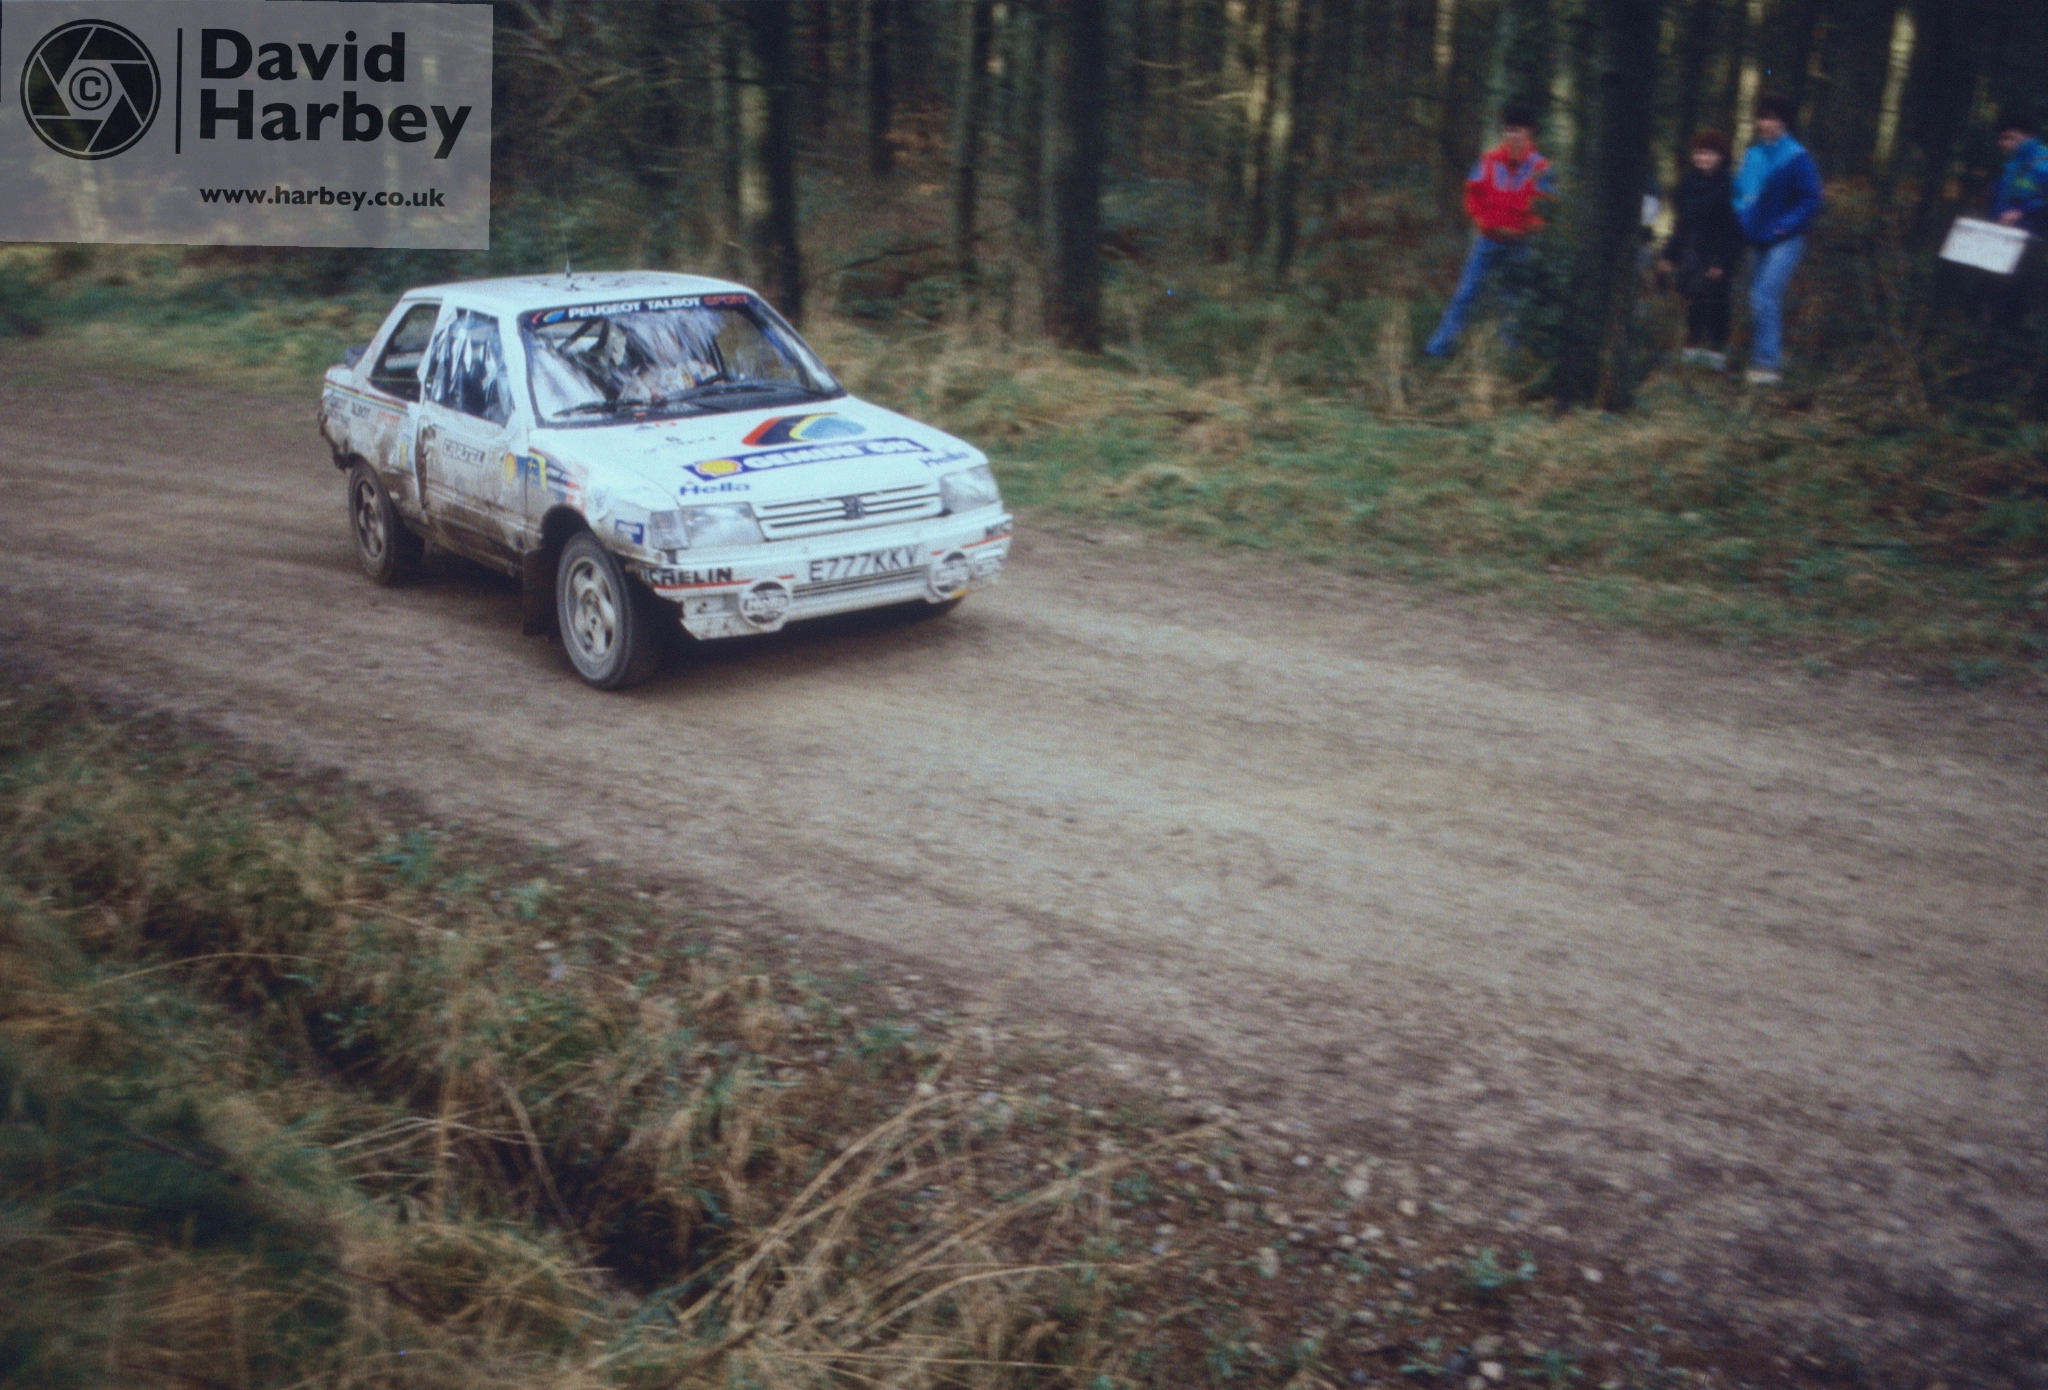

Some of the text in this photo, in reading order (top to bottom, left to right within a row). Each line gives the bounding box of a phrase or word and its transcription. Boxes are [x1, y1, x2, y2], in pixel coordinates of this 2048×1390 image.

[568, 294, 749, 319] PEUGEOT TALBOT SPORT
[679, 480, 750, 496] Hella
